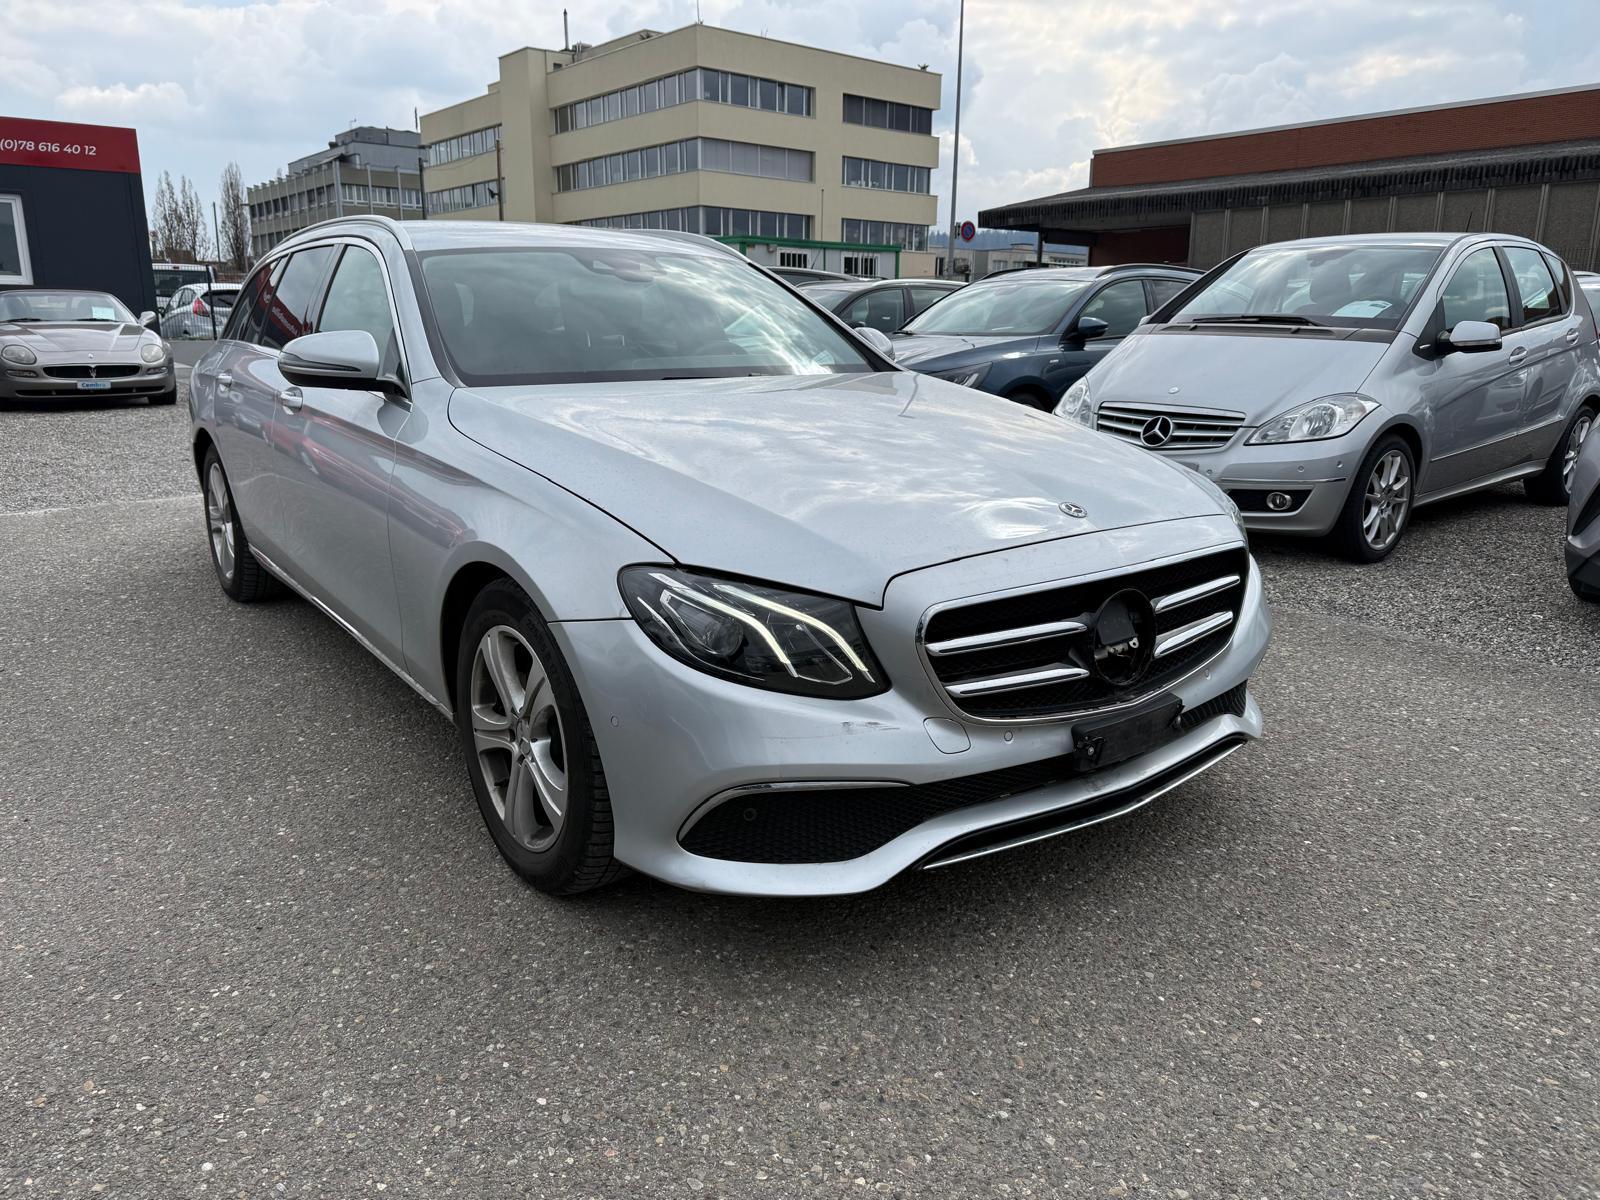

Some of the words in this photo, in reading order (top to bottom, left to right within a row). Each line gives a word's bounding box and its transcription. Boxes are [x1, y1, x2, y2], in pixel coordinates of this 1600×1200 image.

[0, 138, 35, 152] (0)78
[38, 142, 60, 153] 616
[63, 144, 81, 155] 40
[84, 145, 97, 156] 12
